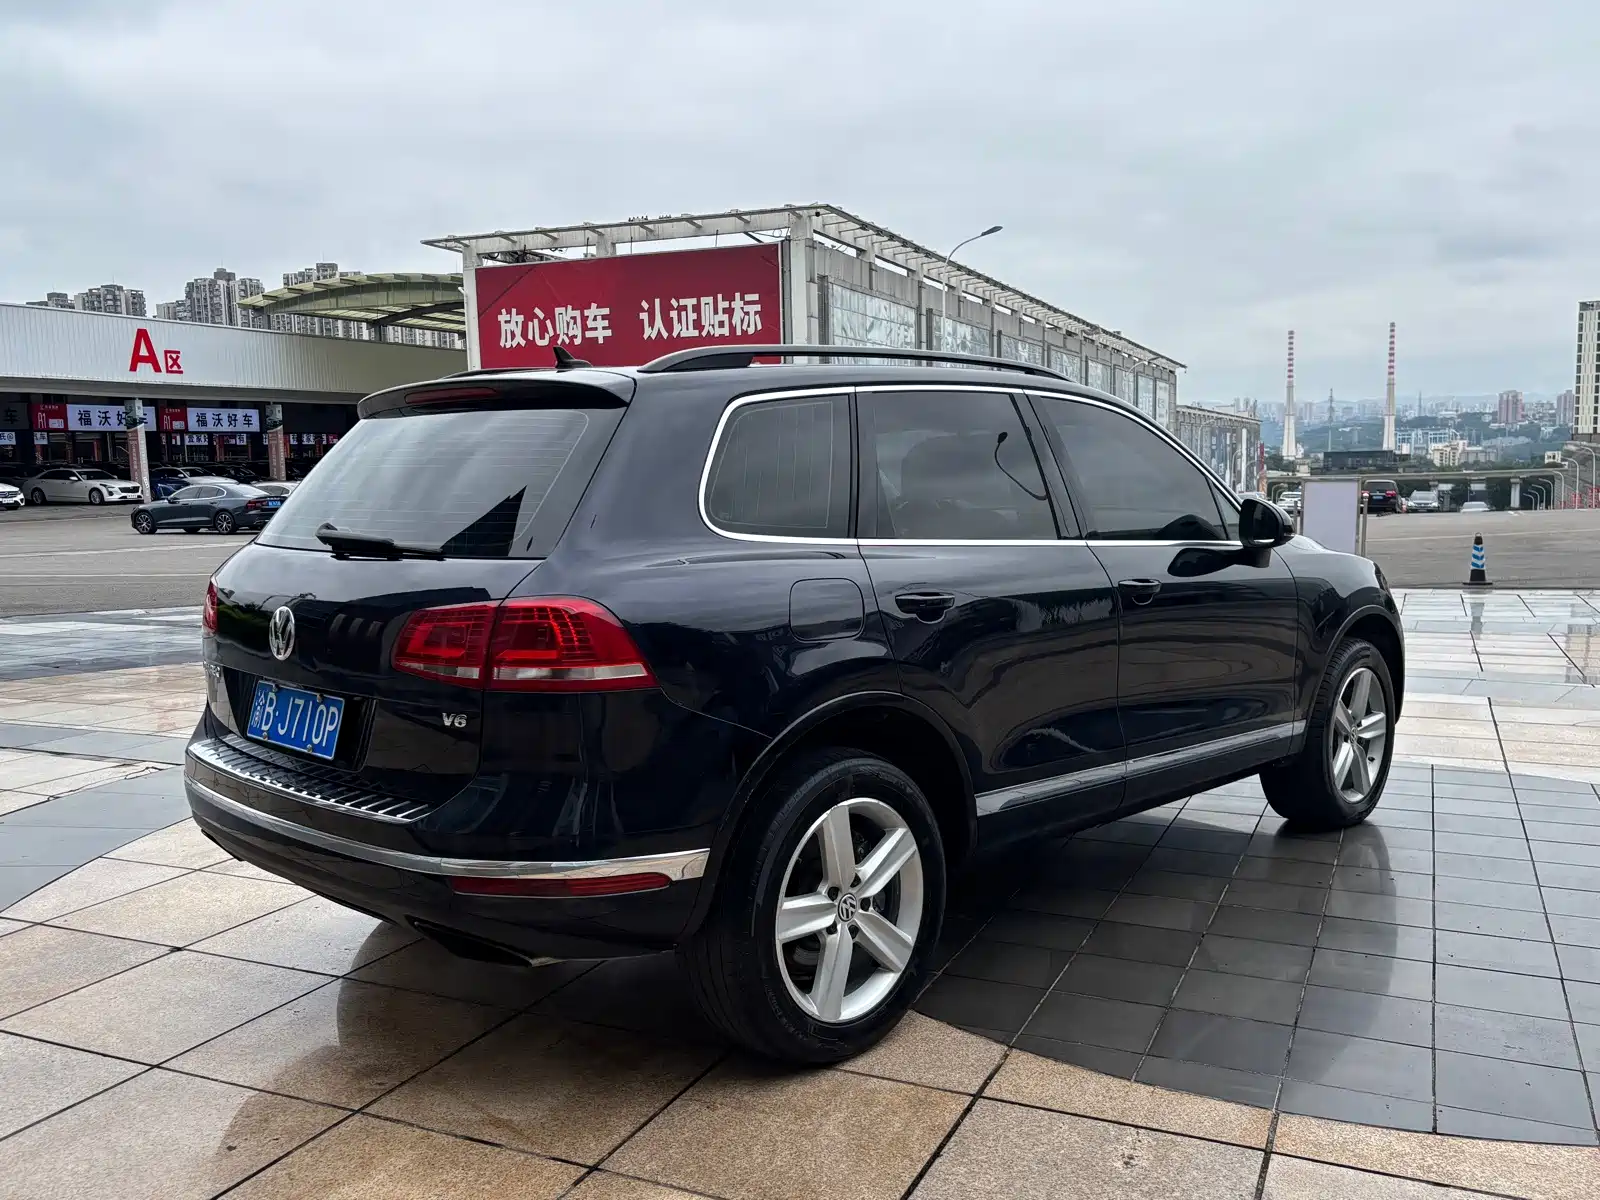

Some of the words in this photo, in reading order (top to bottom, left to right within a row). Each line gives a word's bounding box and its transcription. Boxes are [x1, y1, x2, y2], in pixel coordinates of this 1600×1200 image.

[498, 302, 612, 348] 放心购车
[639, 292, 763, 340] 认证贴标
[129, 328, 184, 374] A区
[195, 412, 254, 428] 福沃好车
[442, 712, 468, 728] V6
